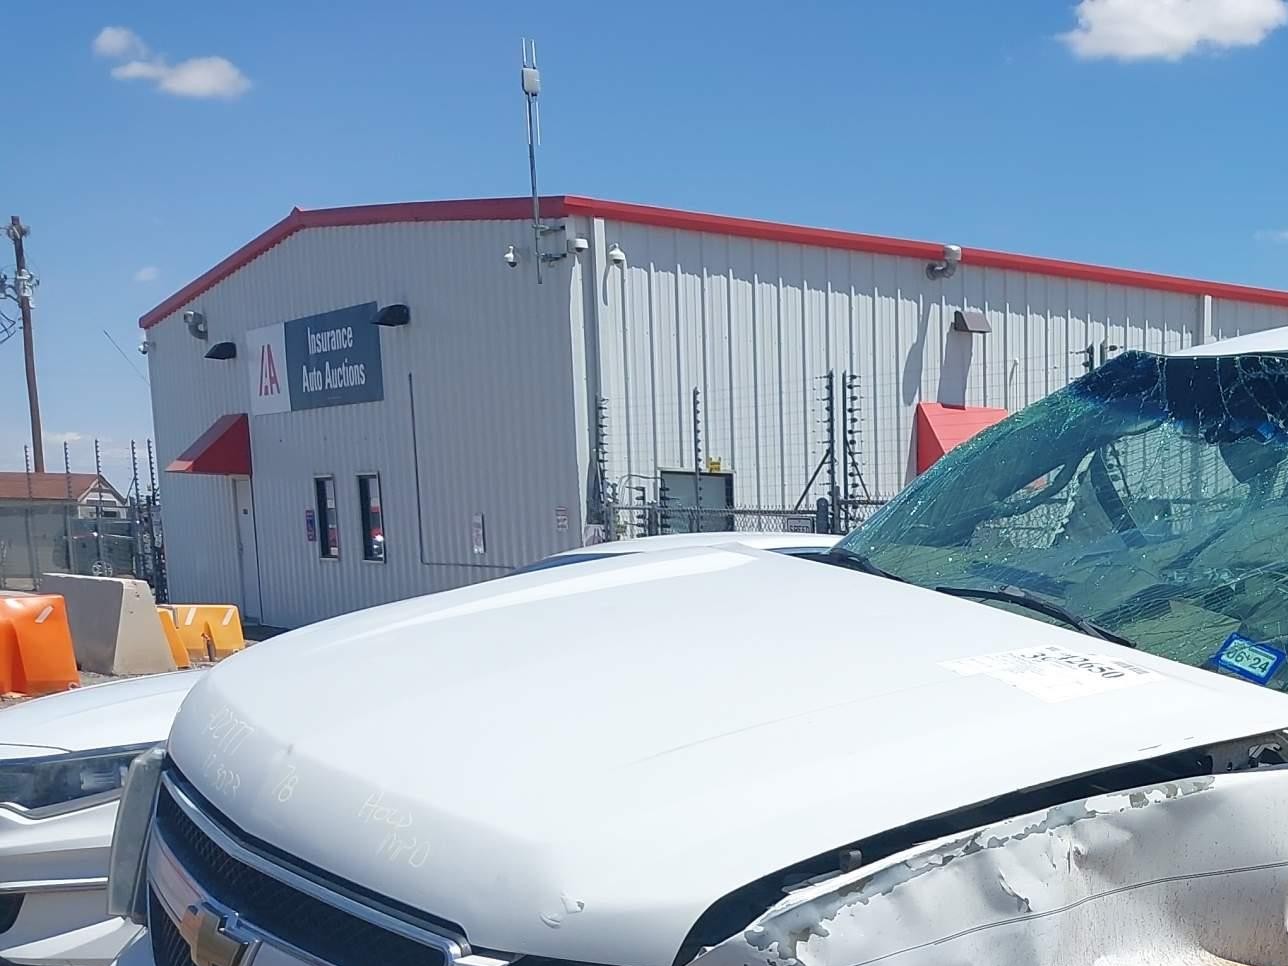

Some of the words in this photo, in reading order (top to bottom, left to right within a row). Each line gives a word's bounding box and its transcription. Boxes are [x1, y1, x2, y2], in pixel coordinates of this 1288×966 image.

[307, 325, 354, 355] Insurance
[302, 365, 323, 393] Auto
[325, 357, 366, 390] Auctions
[1248, 656, 1270, 673] 24
